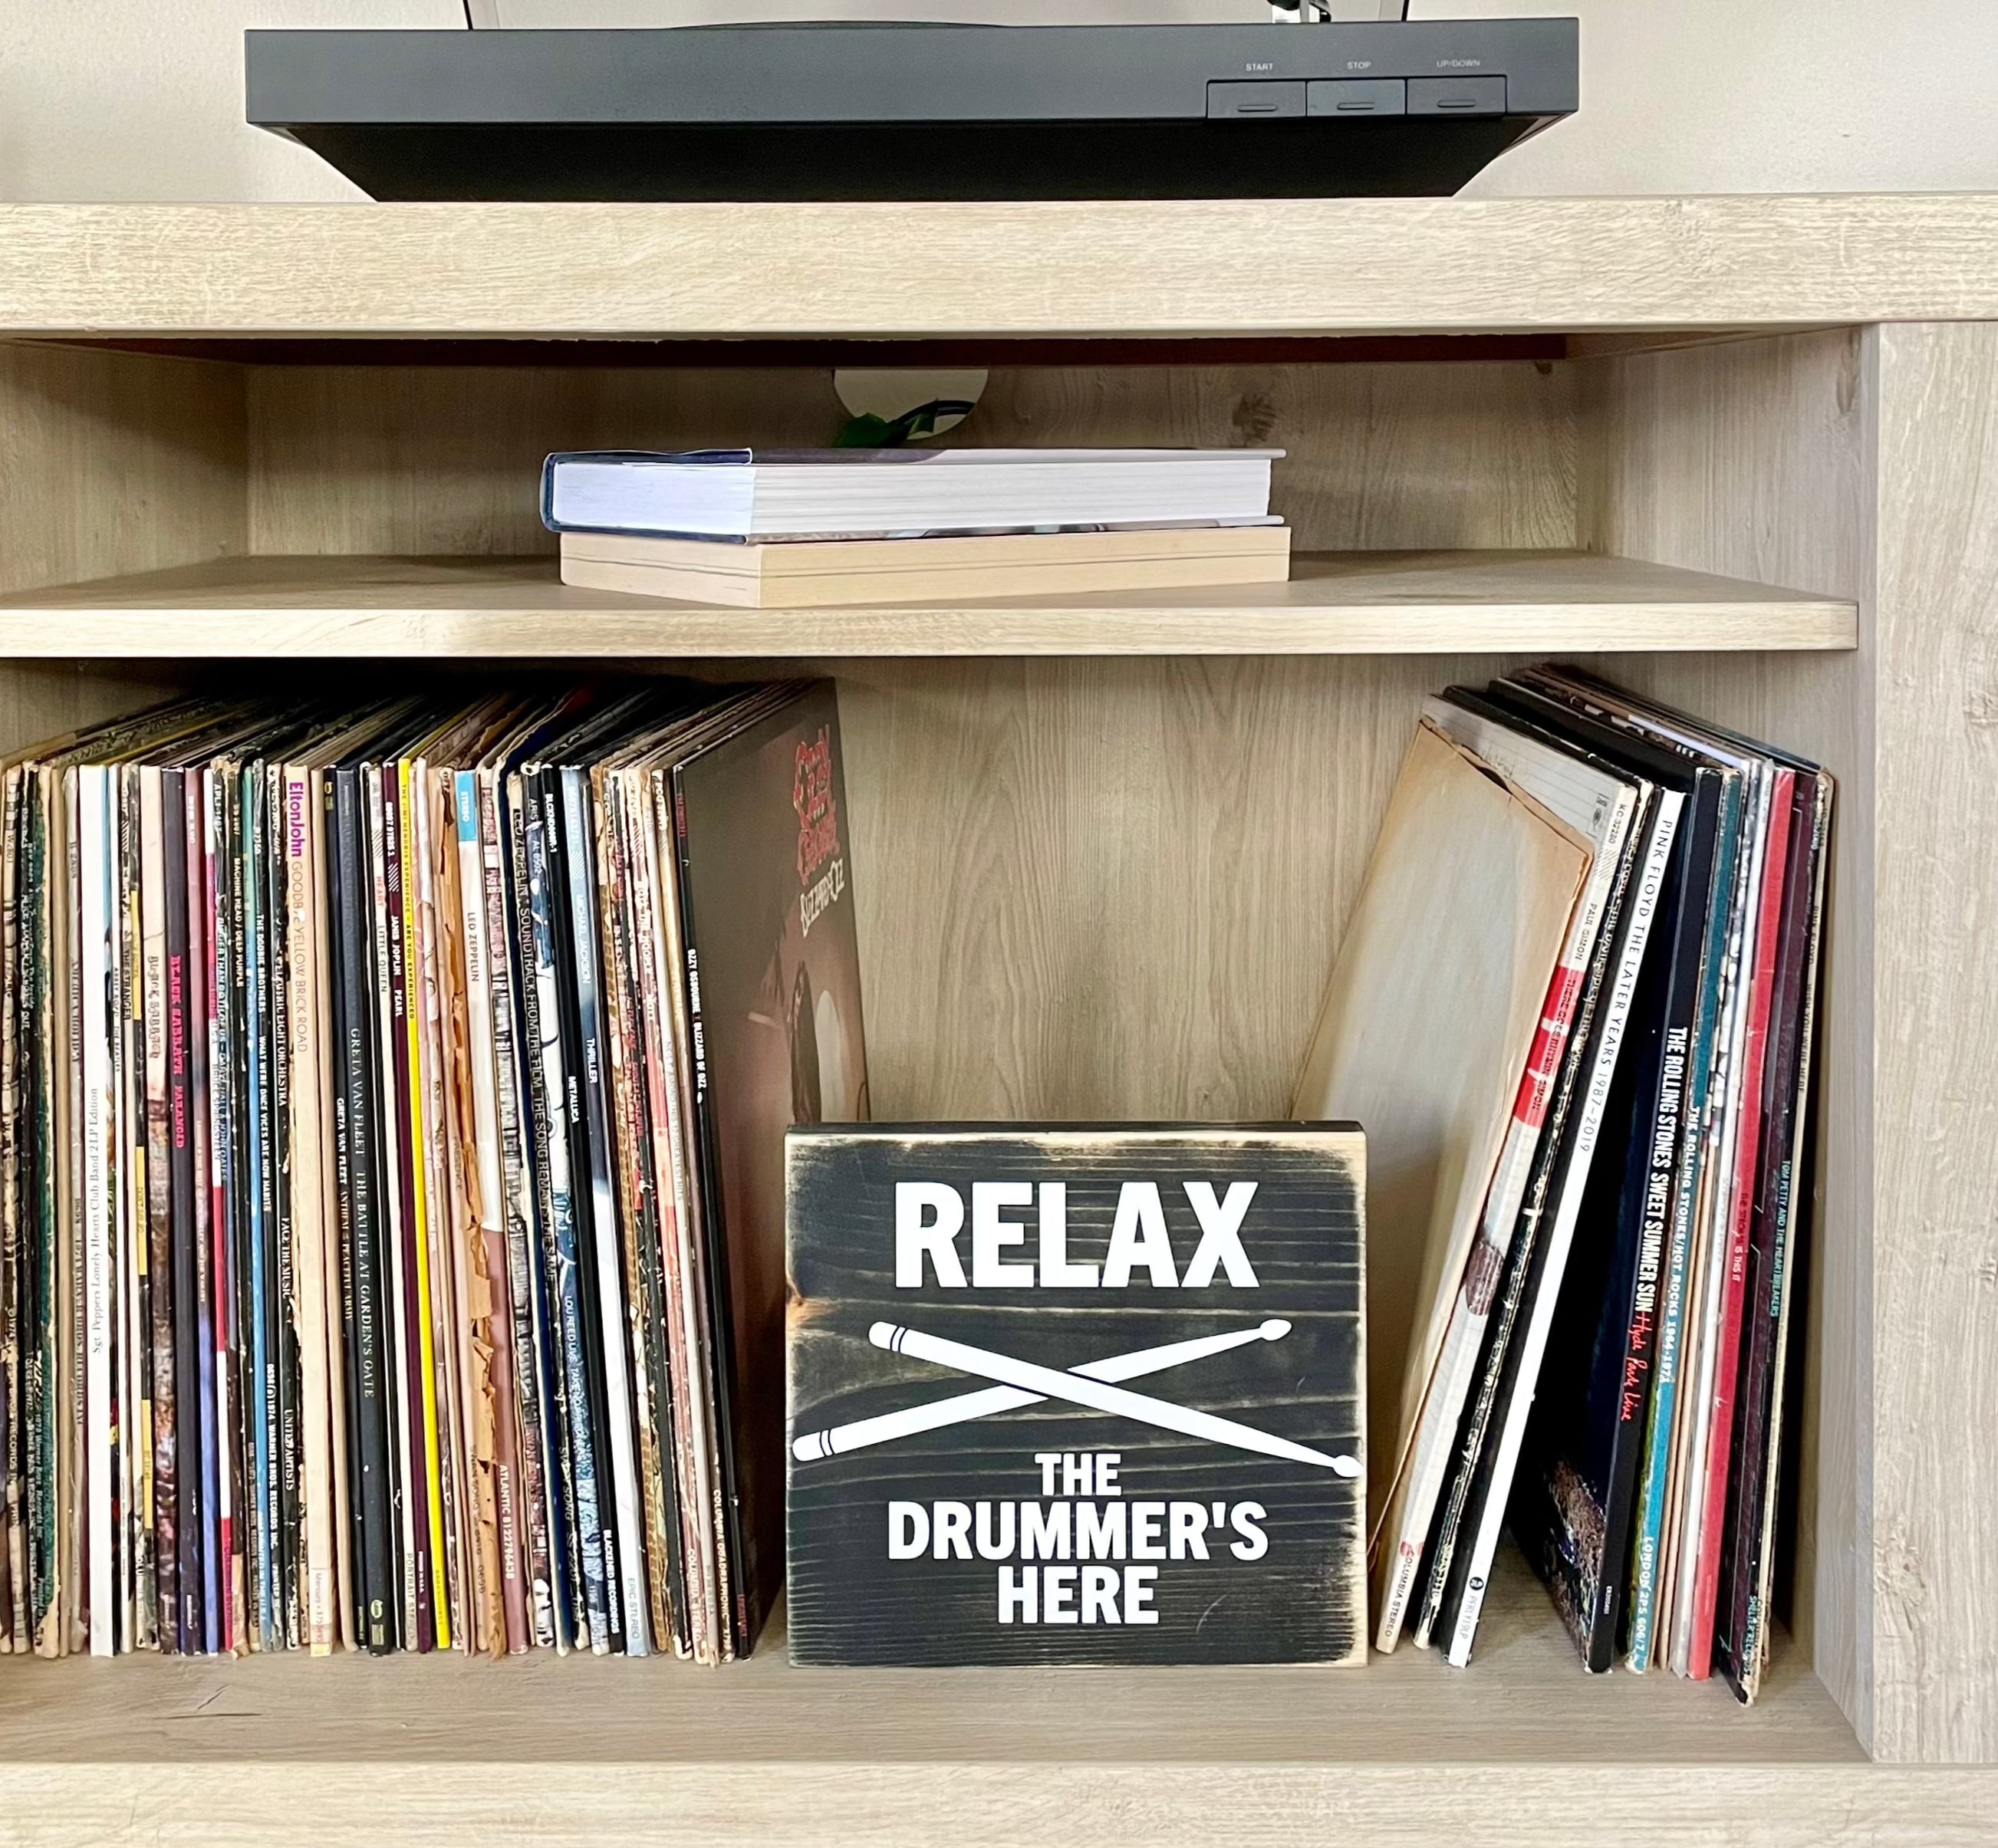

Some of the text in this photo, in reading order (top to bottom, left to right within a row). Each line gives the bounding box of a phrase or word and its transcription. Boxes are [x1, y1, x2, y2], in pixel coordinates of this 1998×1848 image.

[1246, 62, 1273, 71] START
[1347, 61, 1371, 70] STOP
[1436, 58, 1481, 68] UP/DOWN
[459, 791, 470, 822] STEREO
[1607, 803, 1627, 844] KC 32280
[1651, 819, 1672, 859] PINK
[1637, 864, 1661, 918] FLOYD
[233, 857, 244, 987] MACHINE HEAD DEEP PURPLE
[374, 876, 387, 992] HEART LITTLE QUEEN
[1574, 903, 1598, 961] PAUL SIMON
[1628, 922, 1646, 955] THE
[293, 926, 305, 976] YELLOW
[390, 915, 403, 1017] JANIS JOPLIN PEARL
[466, 912, 479, 982] LED ZEPPELIN
[519, 908, 535, 991] SOUNDTRACK
[147, 955, 162, 1058] BLACK SABBATH
[295, 980, 306, 1014] BRICK
[575, 894, 597, 1083] MICHAEL JACKSON THRILLER
[1559, 978, 1576, 1009] THERE
[1615, 960, 1637, 1010] LATER
[296, 1016, 307, 1051] ROAD
[525, 994, 538, 1029] FROM
[687, 949, 706, 1088] OZZY OSBOURNE BLIZZARD OF OZZ
[170, 955, 185, 1148] BLACK SABBATH PARANOID
[255, 914, 269, 1178] THE DOOBIE BROTHERS WHAT WERE ONCE VICES ARE NOW
[528, 1034, 540, 1056] THE
[1600, 1015, 1621, 1066] YEARS
[276, 1046, 286, 1106] ORCHESTRA
[530, 1059, 542, 1088] FILM
[1531, 1078, 1548, 1110] SIMON
[88, 1088, 98, 1125] Edition
[532, 1097, 545, 1120] THE
[567, 1075, 579, 1123] METALLICA
[1687, 1105, 1700, 1130] THE
[89, 1128, 98, 1143] LP
[534, 1123, 547, 1158] SONG
[89, 1155, 100, 1181] Band
[453, 1135, 462, 1190] PRESENCE
[1680, 1133, 1697, 1188] ROLLING
[90, 1185, 100, 1210] Club
[336, 1097, 354, 1320] GRETA VAN FLEET ANTHEM PEACEFUL ARMY
[350, 1028, 374, 1398] GRETA VAN FLEET THE BATTLE AT GARDEN'S GATE
[90, 1214, 100, 1247] Hearts
[280, 1217, 289, 1245] FACE
[542, 1220, 553, 1241] THE
[894, 1181, 1261, 1288] RELAX
[1619, 1025, 1687, 1422] THE ROLLING STONES SWEET SUMMER SUN Hyde Park Live
[1672, 1192, 1690, 1271] STONES/HOT
[1769, 1159, 1790, 1317] TOM PETTY AND THE HEARTBREAKERS
[91, 1251, 101, 1286] Lonely
[280, 1245, 290, 1267] THE
[545, 1245, 555, 1281] SAME
[1732, 1255, 1742, 1272] THIS
[1733, 1245, 1743, 1254] IS
[1667, 1274, 1681, 1317] ROCKS
[1731, 1273, 1740, 1281] IT
[91, 1290, 102, 1330] Peppers
[564, 1295, 579, 1386] LOU REED TAKE
[268, 1424, 278, 1549] WARNER RECORDS INC.
[284, 1448, 295, 1491] ARTISTS
[499, 1464, 510, 1514] ATLANTIC
[1035, 1452, 1123, 1496] THE
[562, 1486, 572, 1520] SONG
[711, 1488, 729, 1618] COLUMBIA QUADRAPHONIC
[887, 1501, 1269, 1561] DRUMMER'S
[313, 1572, 323, 1603] Mercury
[404, 1553, 414, 1599] PORTRAIT
[602, 1529, 619, 1633] BLACKENED RECORDINGS
[997, 1565, 1160, 1625] HERE
[1384, 1550, 1414, 1637] COLUMBIA STEREO
[1634, 1536, 1654, 1650] LONDON 2PS 606/7
[627, 1577, 640, 1638] EPIC STEREO
[1746, 1594, 1757, 1632] SHELTER
